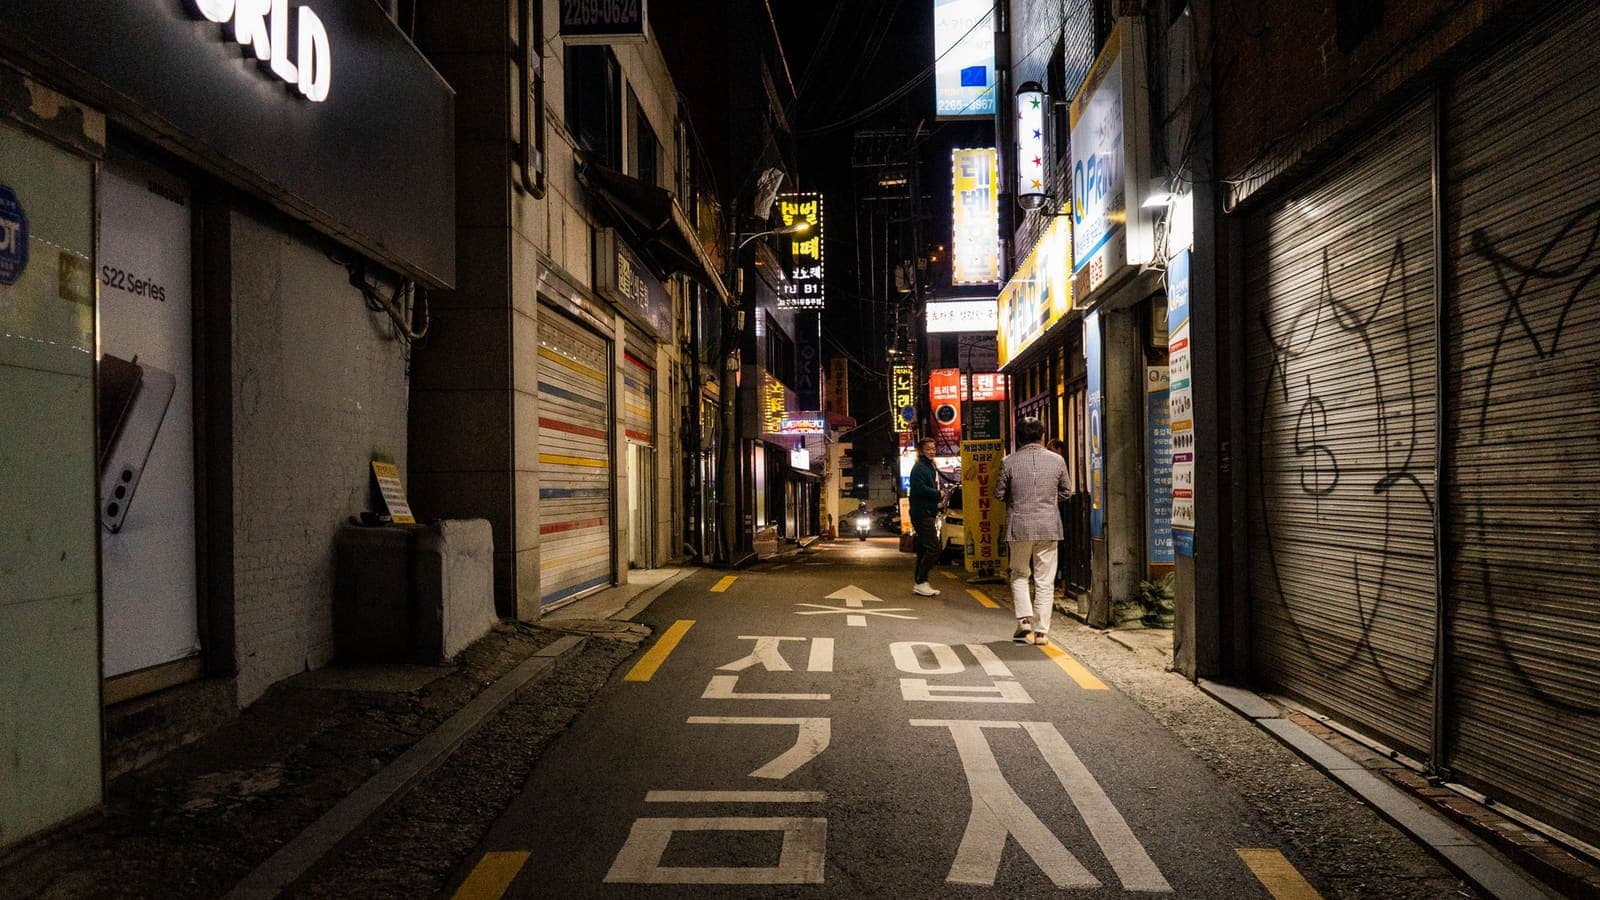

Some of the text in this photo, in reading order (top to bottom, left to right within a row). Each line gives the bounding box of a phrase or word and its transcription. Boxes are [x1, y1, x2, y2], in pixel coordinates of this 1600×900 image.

[195, 0, 331, 102] RLD
[102, 265, 166, 302] S22 Series
[701, 635, 1035, 704] 진입
[601, 715, 1174, 893] 금지
